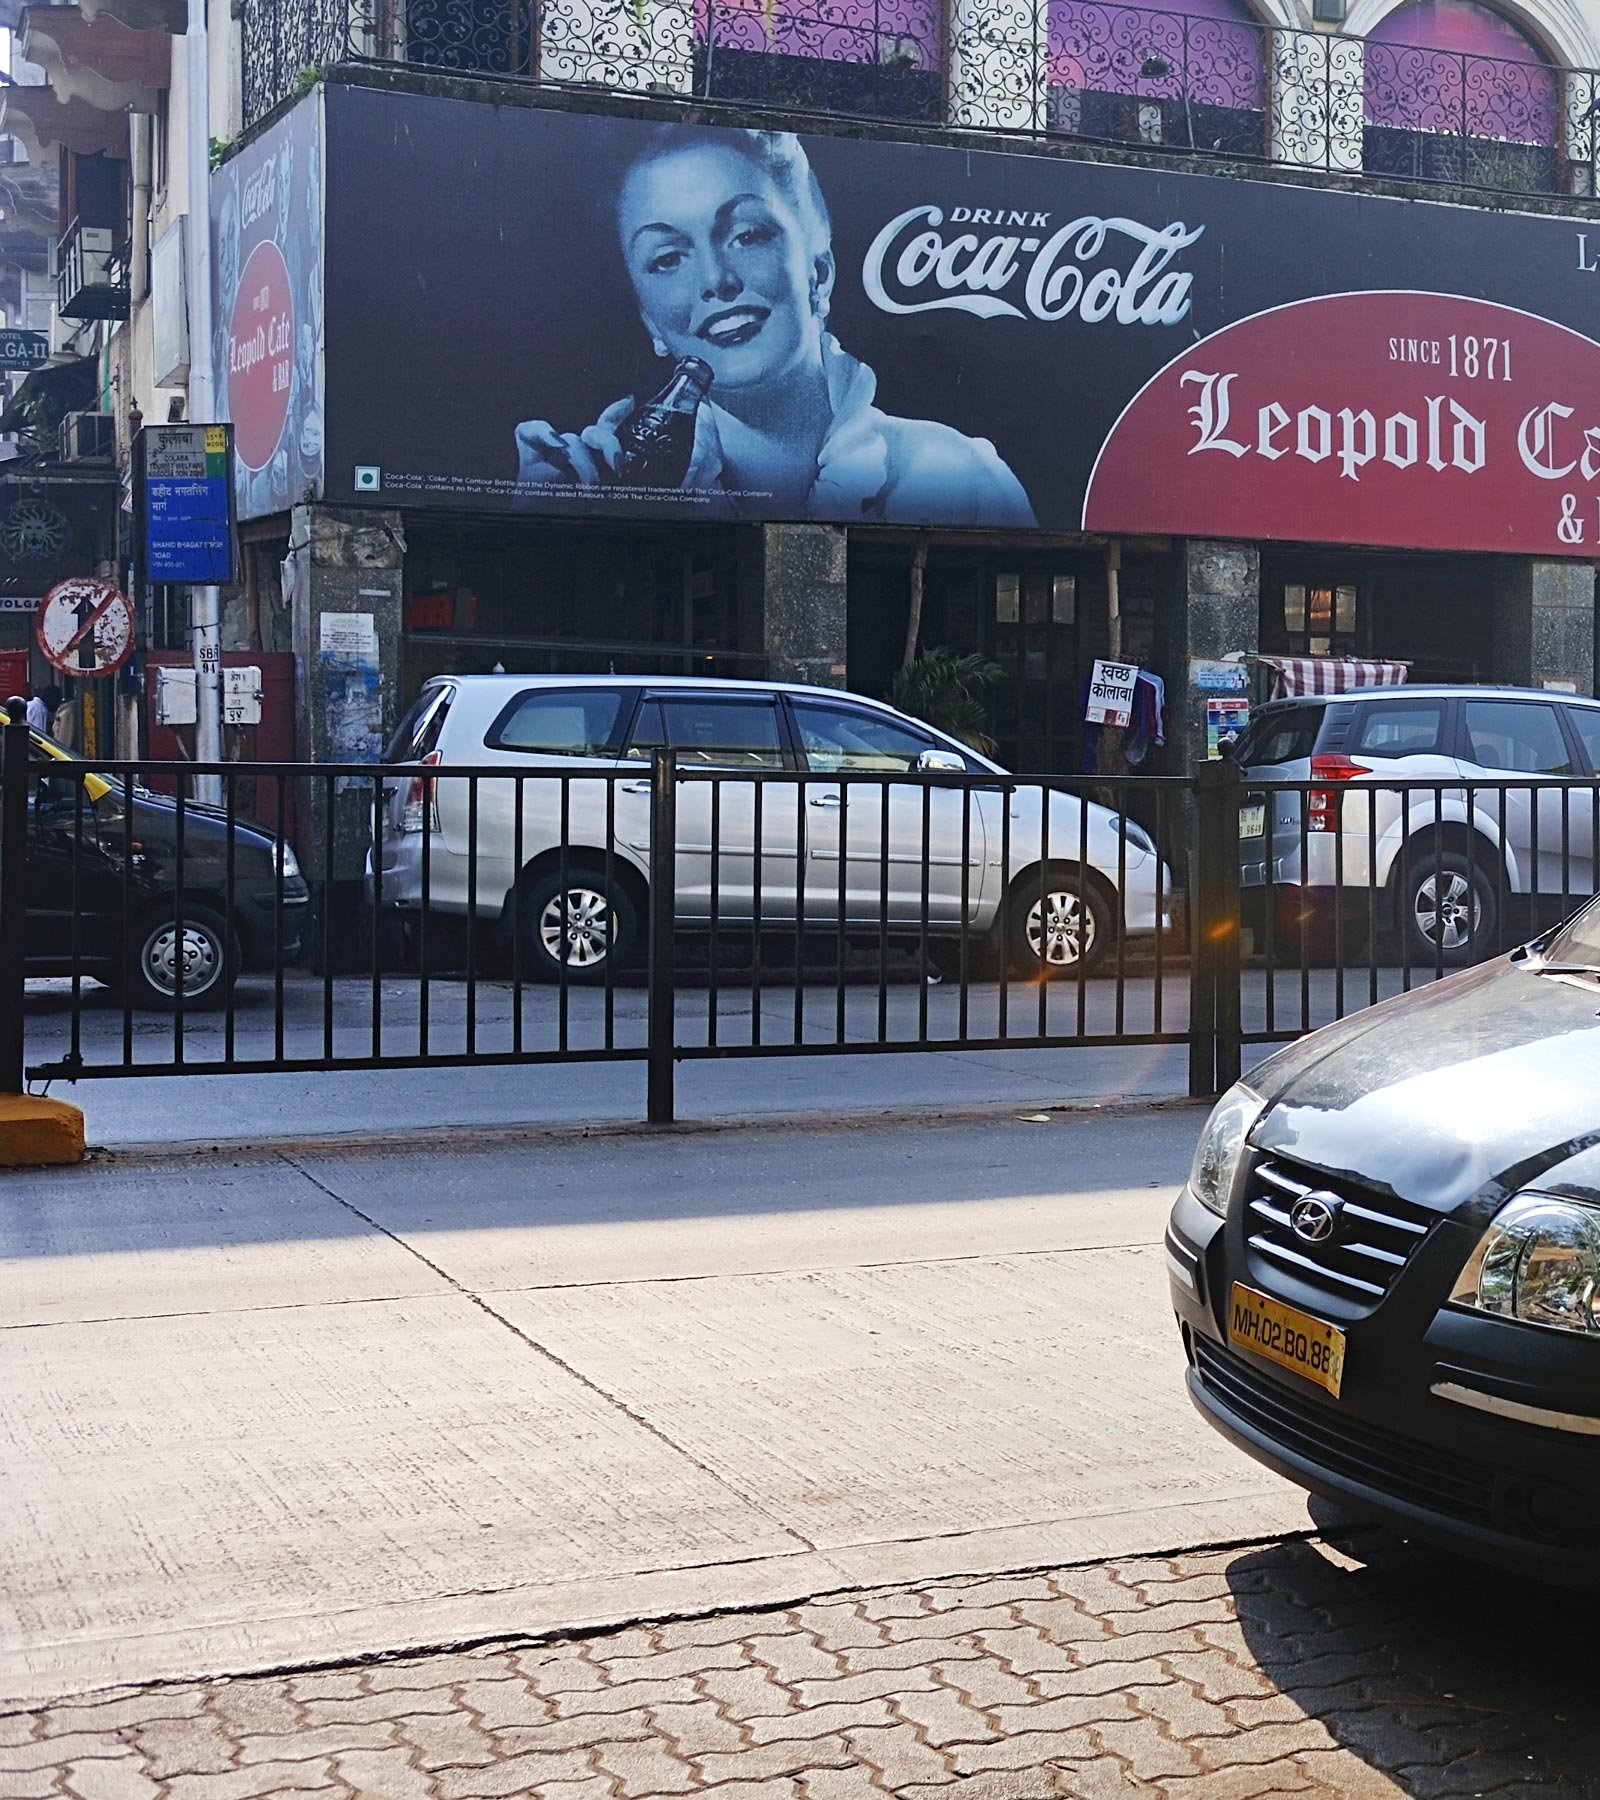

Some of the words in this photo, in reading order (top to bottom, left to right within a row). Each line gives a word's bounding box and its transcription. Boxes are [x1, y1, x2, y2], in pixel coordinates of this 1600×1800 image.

[242, 153, 276, 230] Coca-Cola
[950, 206, 1051, 228] DRINK
[862, 205, 1206, 327] Coca-Cola
[229, 325, 265, 375] Leopold
[268, 311, 291, 356] Cafe
[1389, 336, 1441, 366] SINCE
[1448, 334, 1513, 382] 1871
[278, 360, 290, 392] BAR
[1179, 369, 1487, 483] Leopold
[465, 477, 493, 485] Contour
[544, 482, 573, 491] Dynamic
[576, 483, 600, 491] Ribbon
[613, 485, 646, 494] registered
[648, 486, 684, 494] trademarks
[695, 487, 706, 495] The
[708, 488, 741, 497] Coca-Cola
[525, 489, 553, 497] contains
[631, 493, 642, 501] The
[644, 494, 678, 502] Coca-Cola
[1556, 493, 1585, 544] &
[1092, 678, 1133, 702] कोलाबा
[1101, 664, 1132, 683] स्वच्छ
